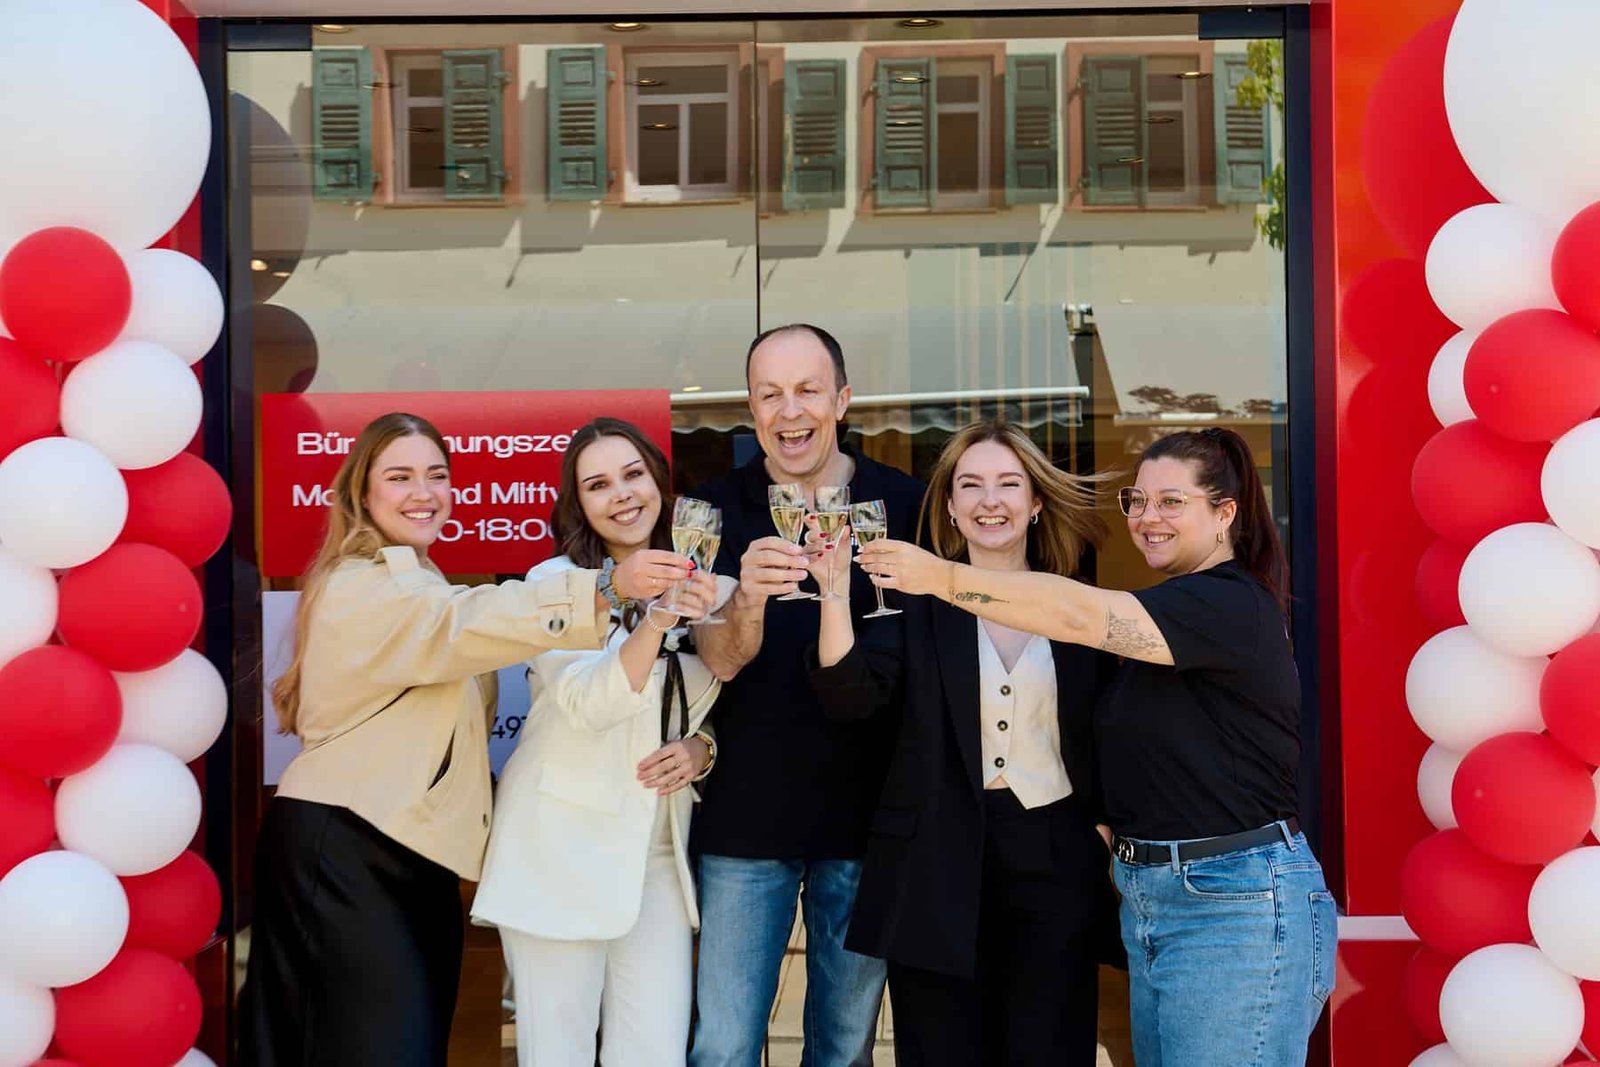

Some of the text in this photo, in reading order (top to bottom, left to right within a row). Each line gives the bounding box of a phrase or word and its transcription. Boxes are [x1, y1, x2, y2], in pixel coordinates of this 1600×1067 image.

[297, 429, 577, 458] Bür nungsze
[292, 482, 558, 507] Mo nd Mitt
[437, 518, 555, 542] 0-18:0
[490, 715, 527, 739] 49
